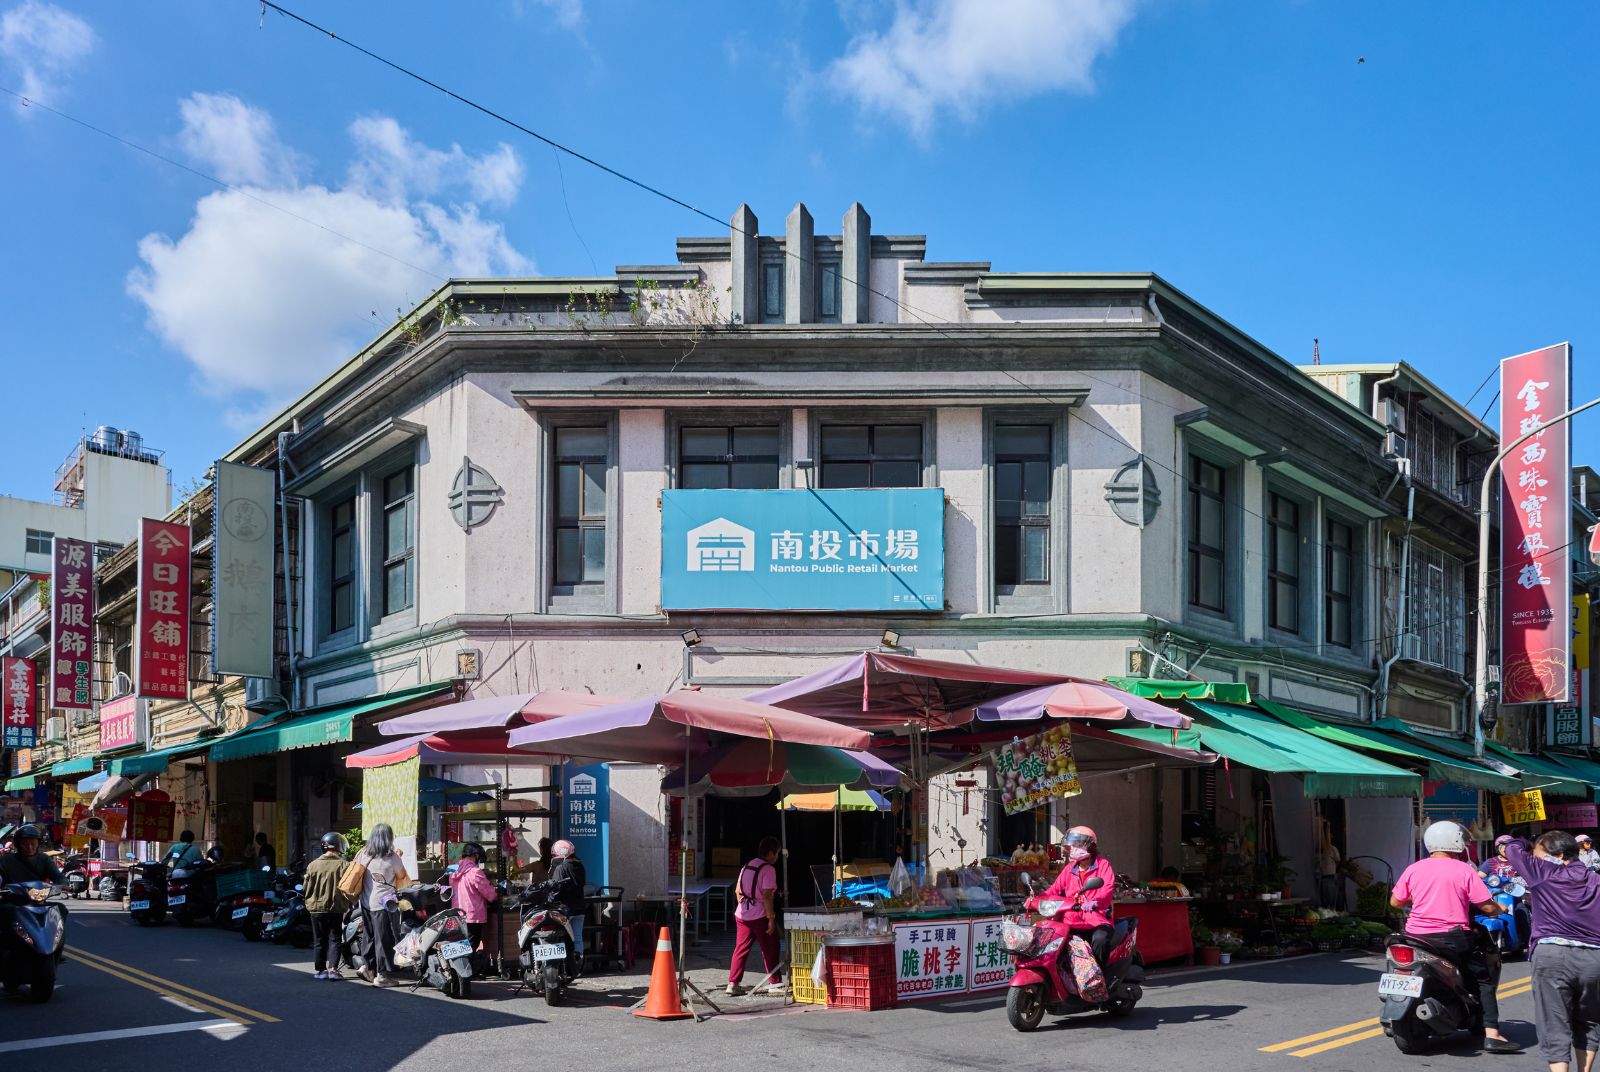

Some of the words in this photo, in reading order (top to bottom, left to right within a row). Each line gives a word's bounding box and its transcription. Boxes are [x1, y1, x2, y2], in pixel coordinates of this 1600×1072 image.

[770, 529, 919, 561] 南投市場
[770, 564, 809, 573] Nantou
[811, 564, 845, 573] Public
[847, 564, 878, 573] Retail
[880, 564, 918, 573] Market
[58, 543, 90, 657] 源美服飾
[1512, 610, 1535, 619] SINCE
[1536, 608, 1555, 616] 1935
[570, 800, 596, 811] 南投
[570, 814, 596, 825] 市場
[909, 928, 956, 943] 手工現醃
[901, 945, 961, 978] 脆桃李
